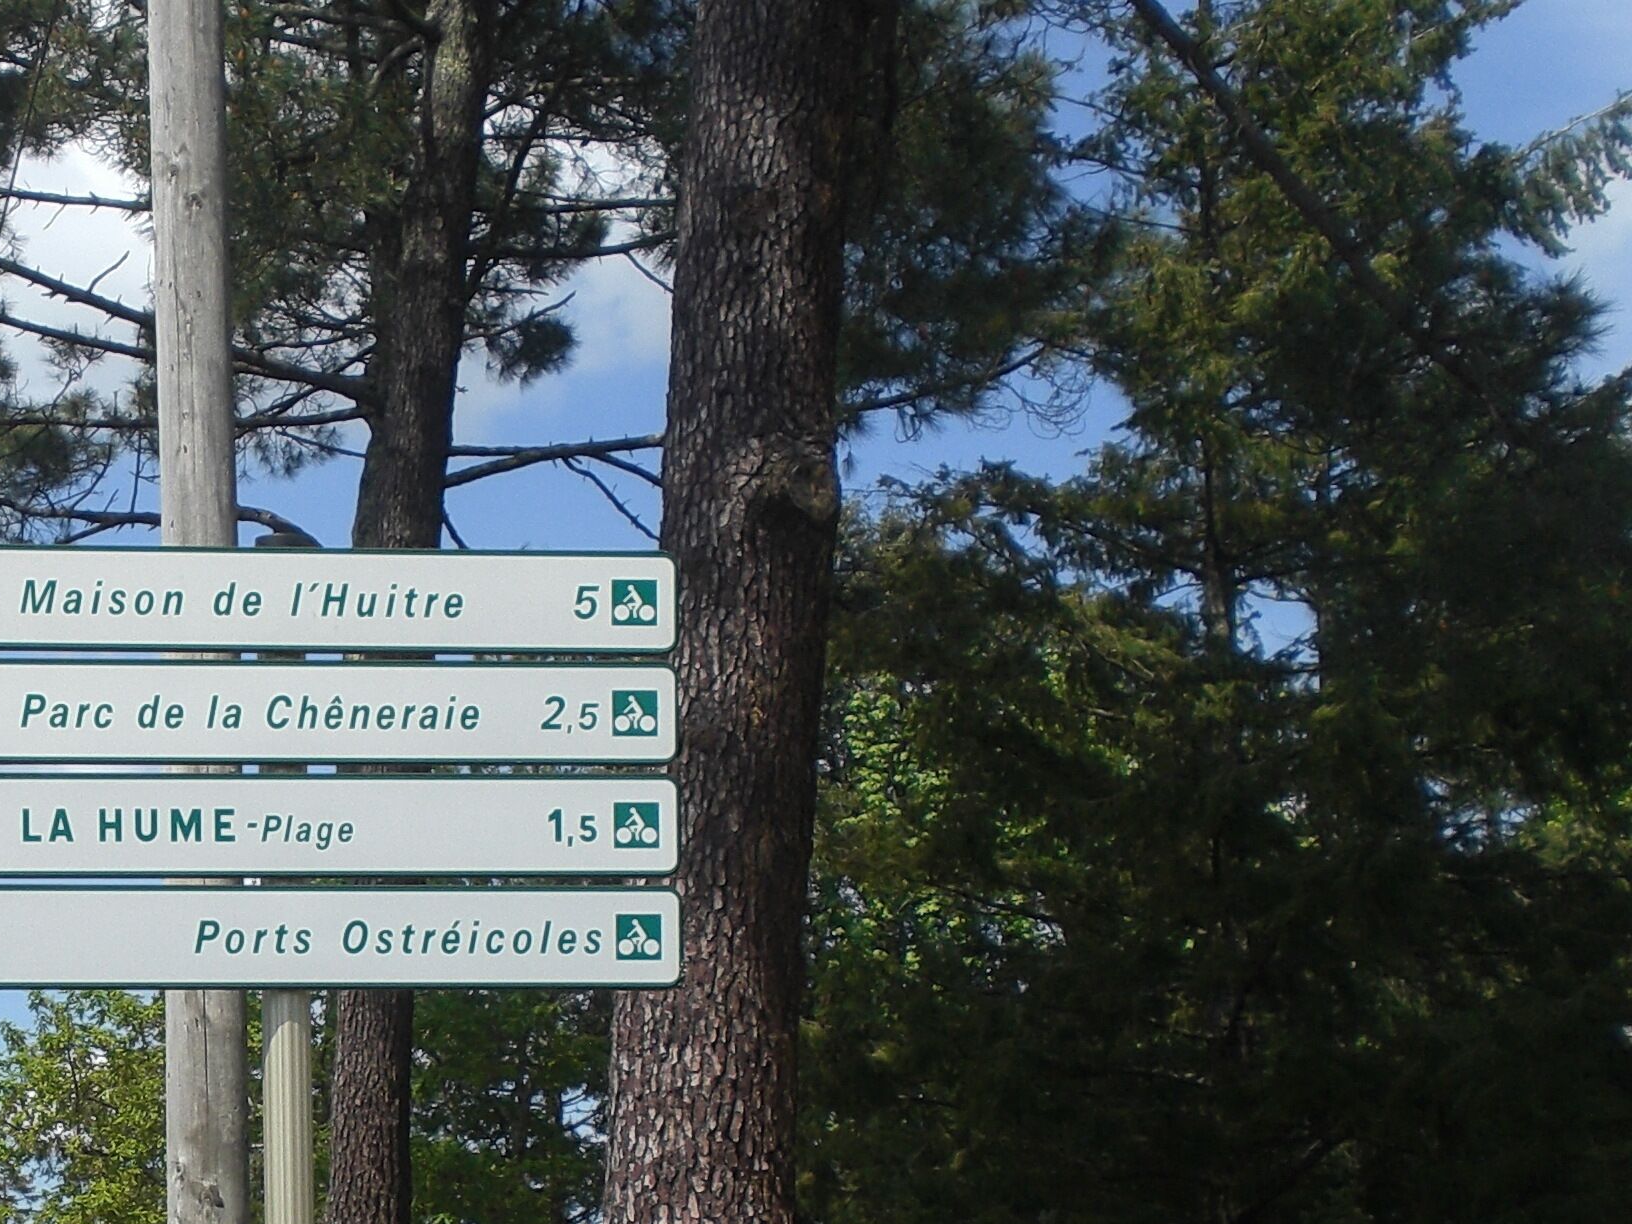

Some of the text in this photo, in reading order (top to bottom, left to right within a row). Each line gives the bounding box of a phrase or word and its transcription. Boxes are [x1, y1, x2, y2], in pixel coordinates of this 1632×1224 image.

[19, 578, 466, 620] Maison de l'Huitre
[572, 584, 601, 621] 5
[19, 692, 481, 732] Parc de la Chêneraie
[539, 694, 601, 736] 2,5
[21, 807, 75, 844] LA
[546, 807, 599, 849] 1,5
[193, 918, 603, 956] Ports Ostréicoles
